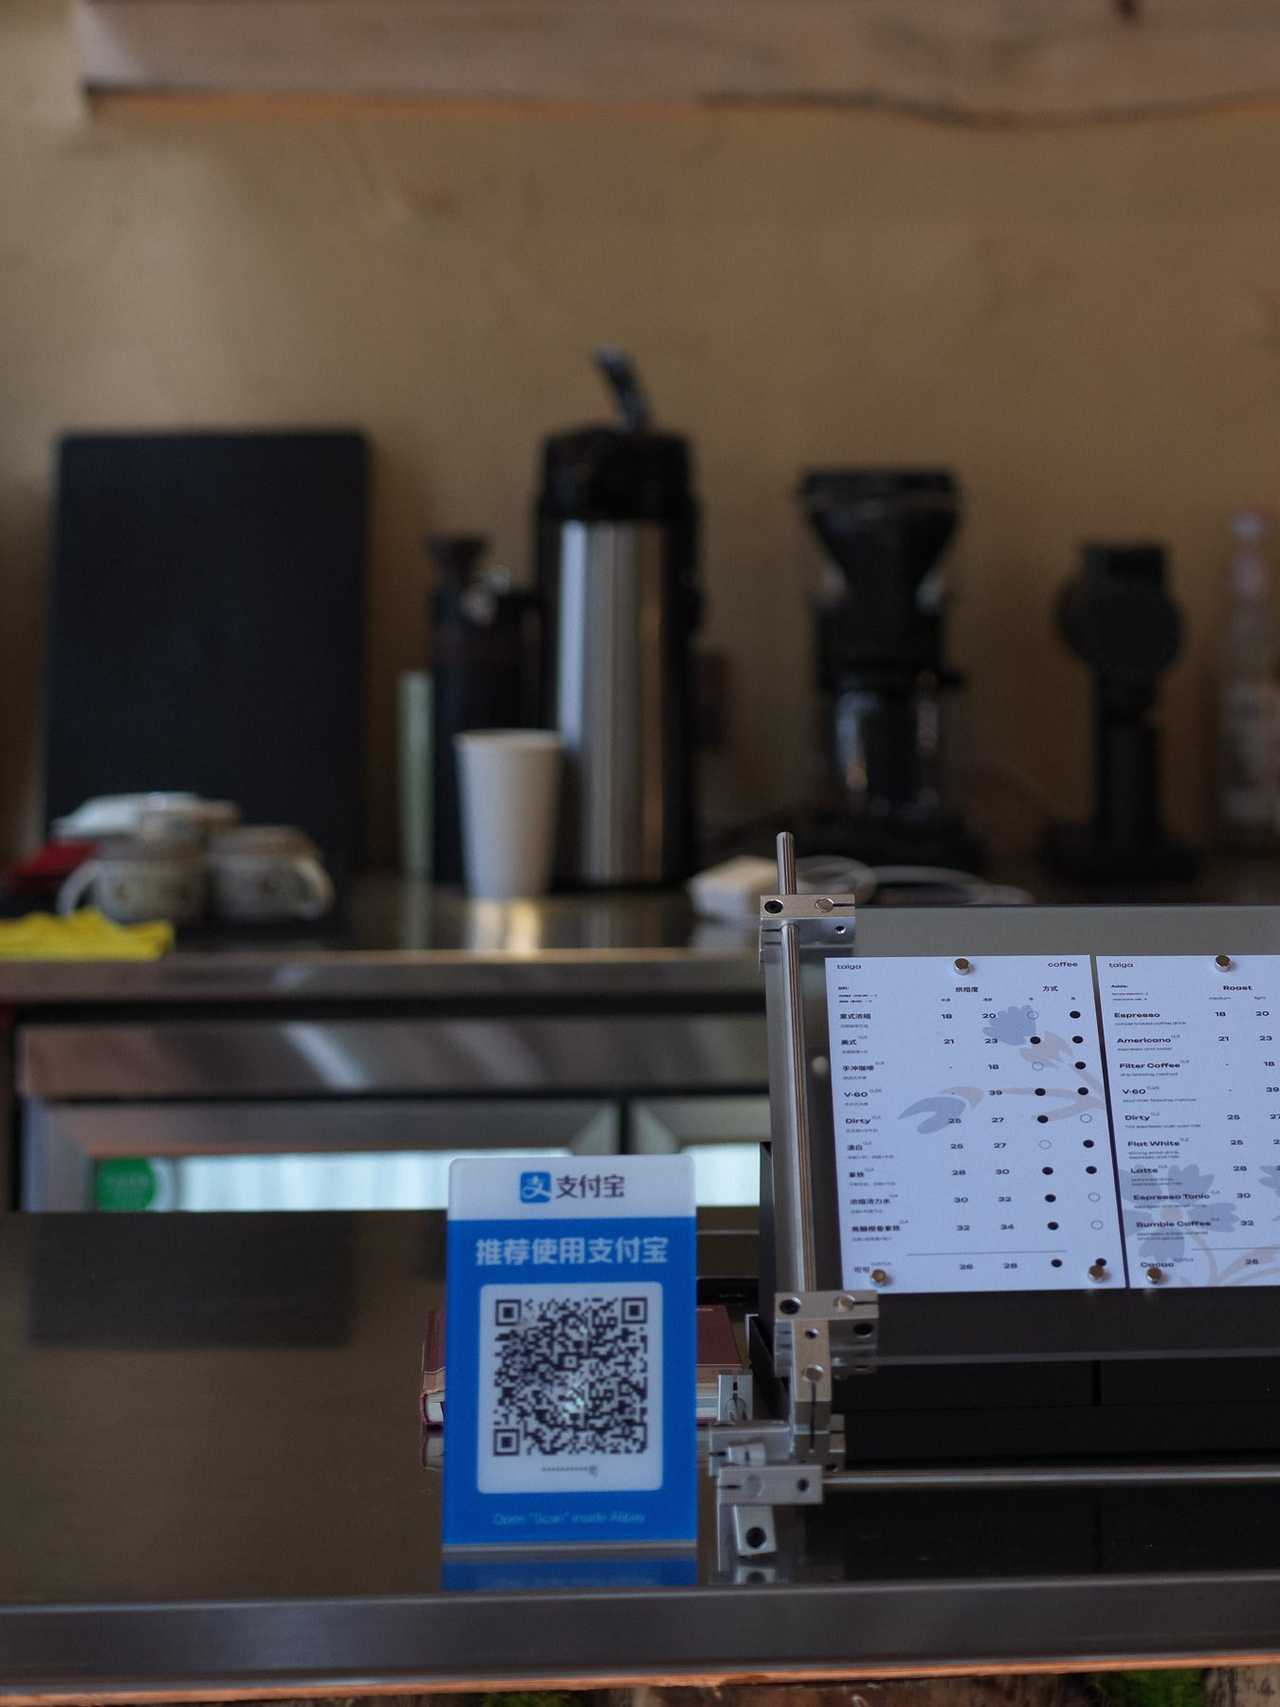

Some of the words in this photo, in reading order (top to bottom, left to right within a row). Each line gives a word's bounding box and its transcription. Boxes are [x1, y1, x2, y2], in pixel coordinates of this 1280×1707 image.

[556, 1175, 625, 1199] 支付宝
[476, 1237, 668, 1266] 推荐使用支付宝
